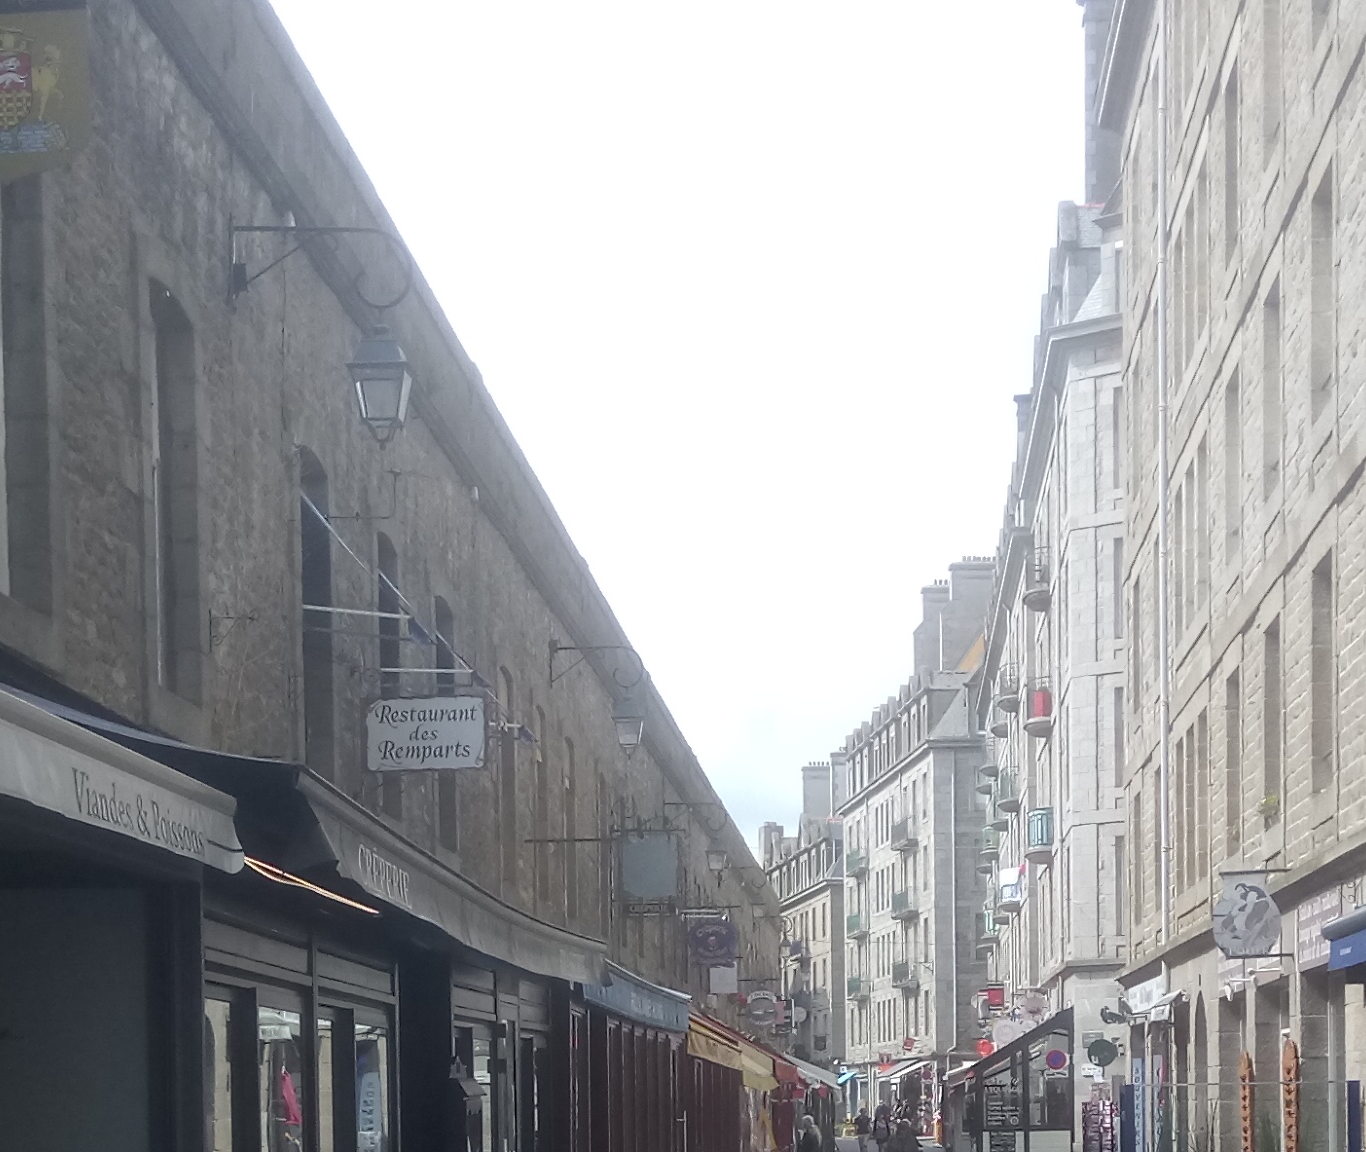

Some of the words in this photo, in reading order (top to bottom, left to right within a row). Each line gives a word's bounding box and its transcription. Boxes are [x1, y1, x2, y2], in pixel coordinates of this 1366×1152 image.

[375, 704, 478, 728] Restaurant
[409, 724, 440, 741] des
[378, 740, 471, 764] Remparts
[71, 767, 134, 832] Viandes
[136, 793, 150, 835] &
[152, 800, 205, 859] Poissons
